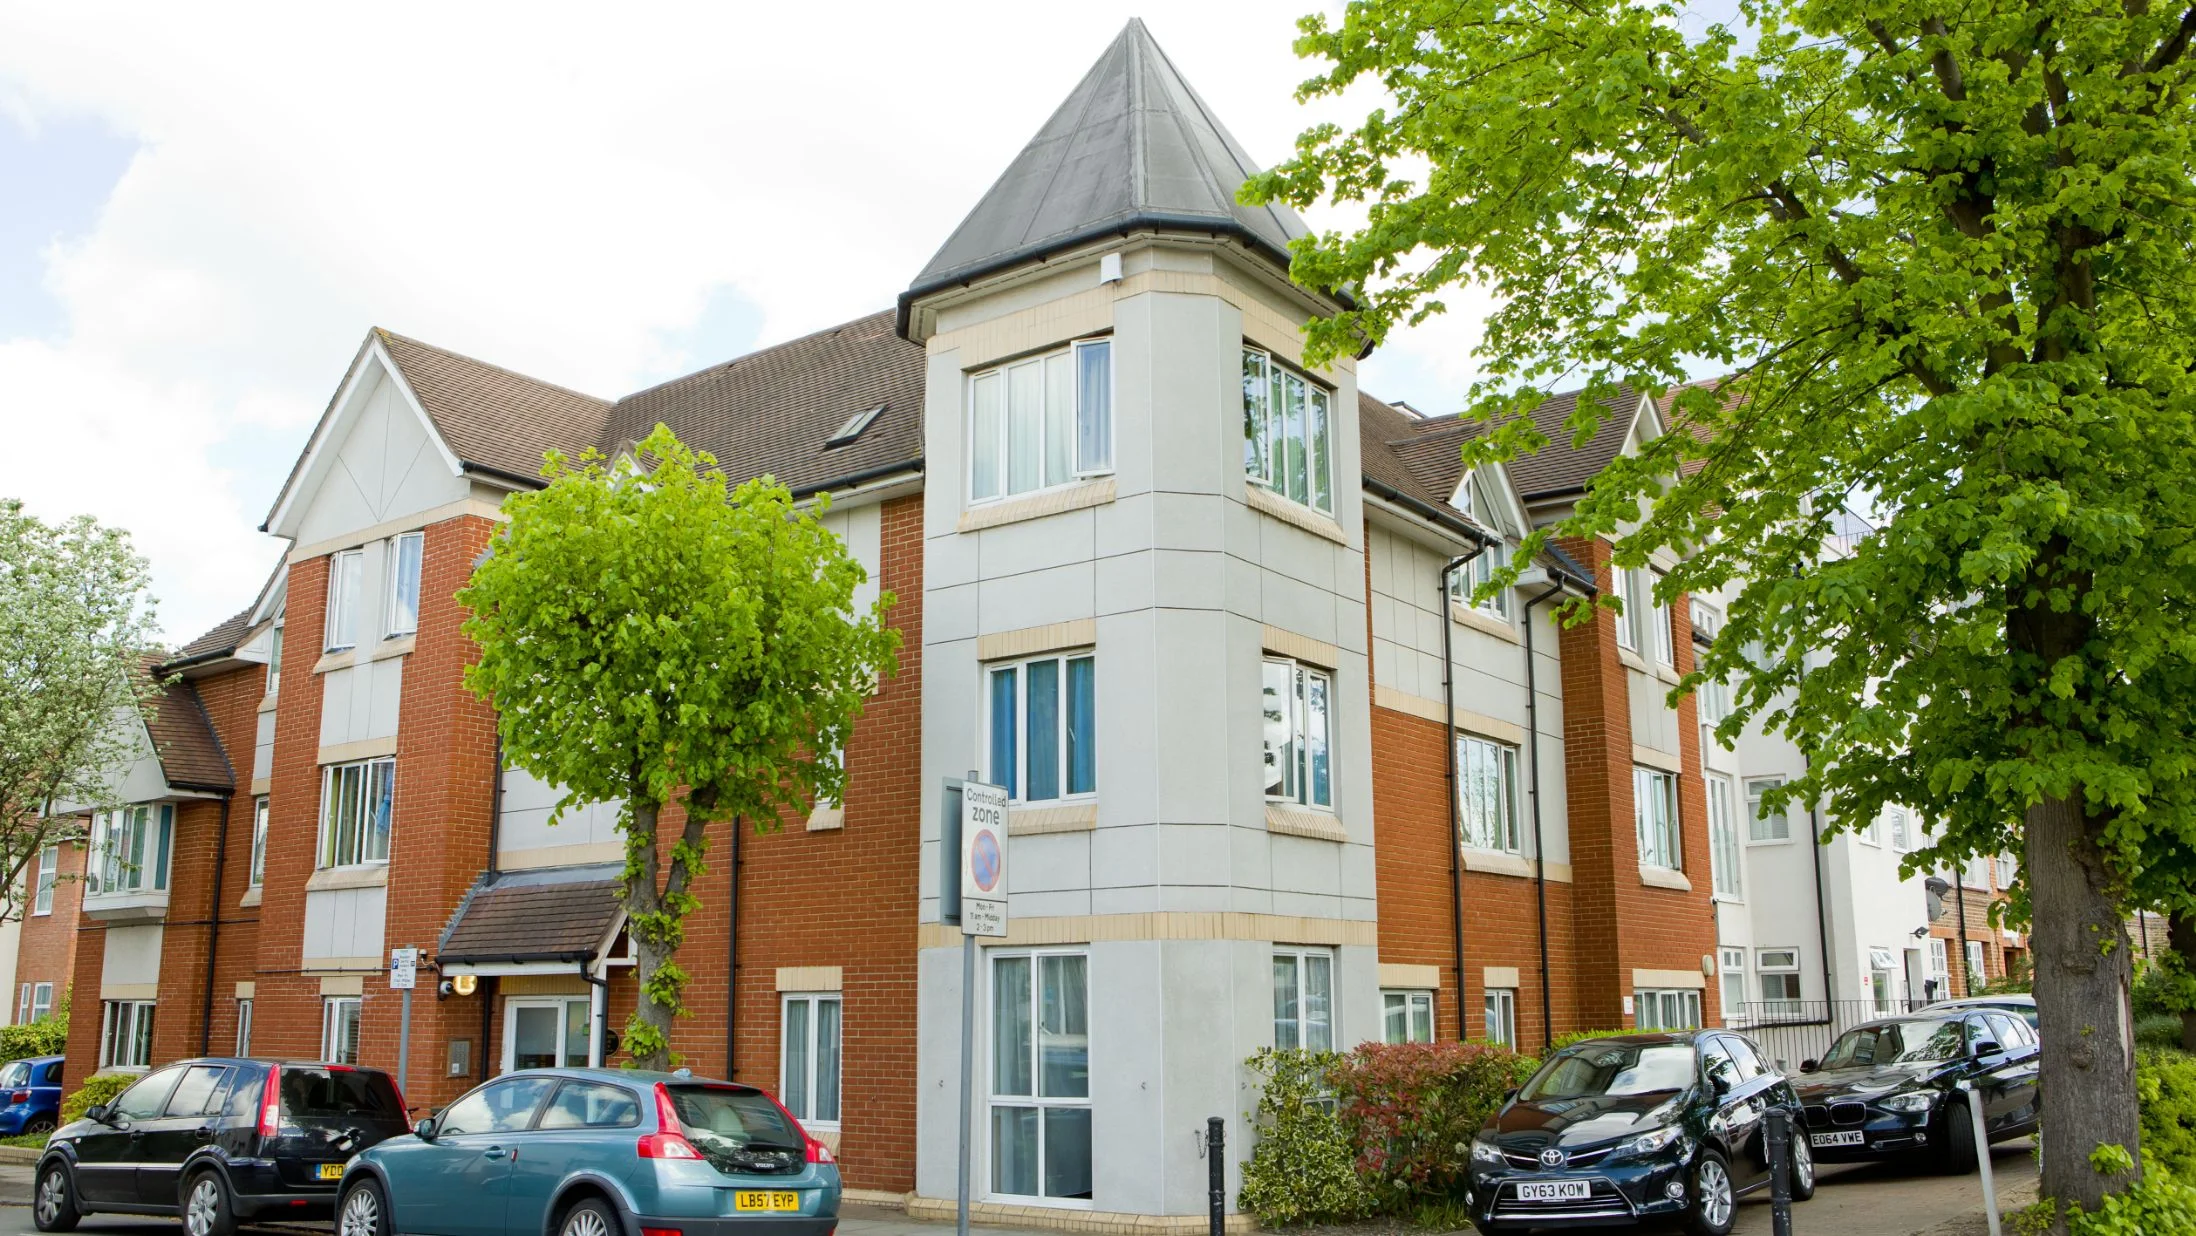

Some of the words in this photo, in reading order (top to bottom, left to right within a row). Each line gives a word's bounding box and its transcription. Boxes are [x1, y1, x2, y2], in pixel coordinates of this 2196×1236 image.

[966, 787, 1006, 807] Controlled
[972, 806, 1000, 825] zone
[1522, 1184, 1555, 1198] GY63
[1559, 1185, 1584, 1197] KOW
[741, 1193, 770, 1208] LB57
[774, 1193, 794, 1207] EYP
